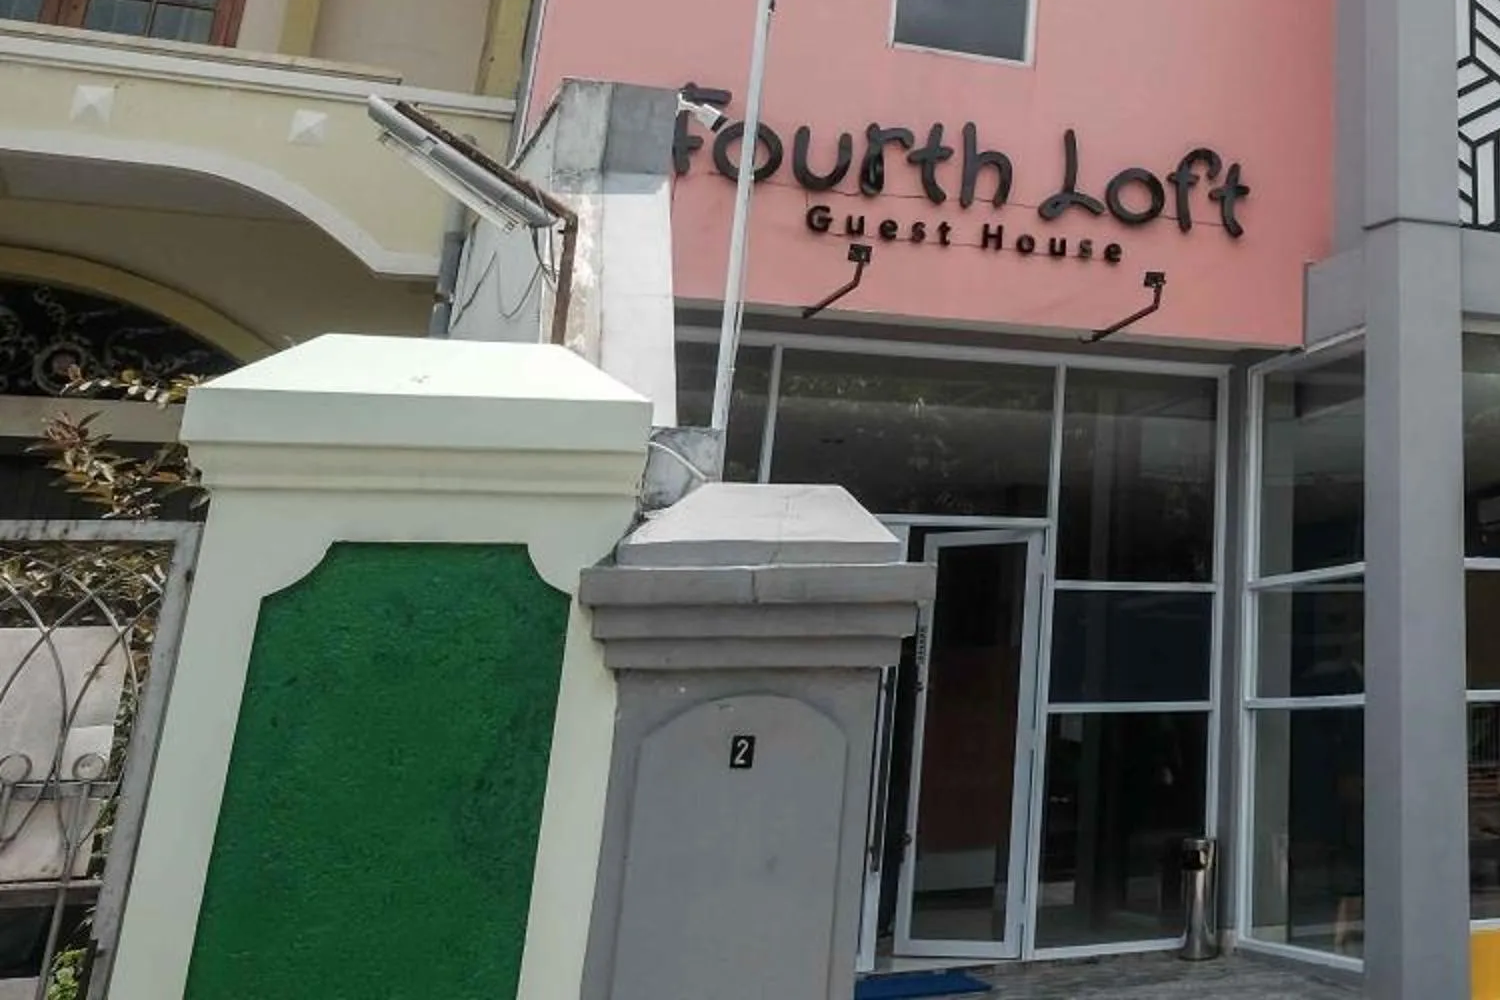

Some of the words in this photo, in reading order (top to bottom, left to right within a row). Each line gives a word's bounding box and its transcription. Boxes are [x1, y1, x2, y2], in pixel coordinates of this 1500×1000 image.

[672, 82, 1013, 210] Fourth
[1038, 128, 1250, 239] Loft
[806, 204, 952, 249] Guest
[981, 223, 1123, 265] House
[735, 739, 749, 765] 2
